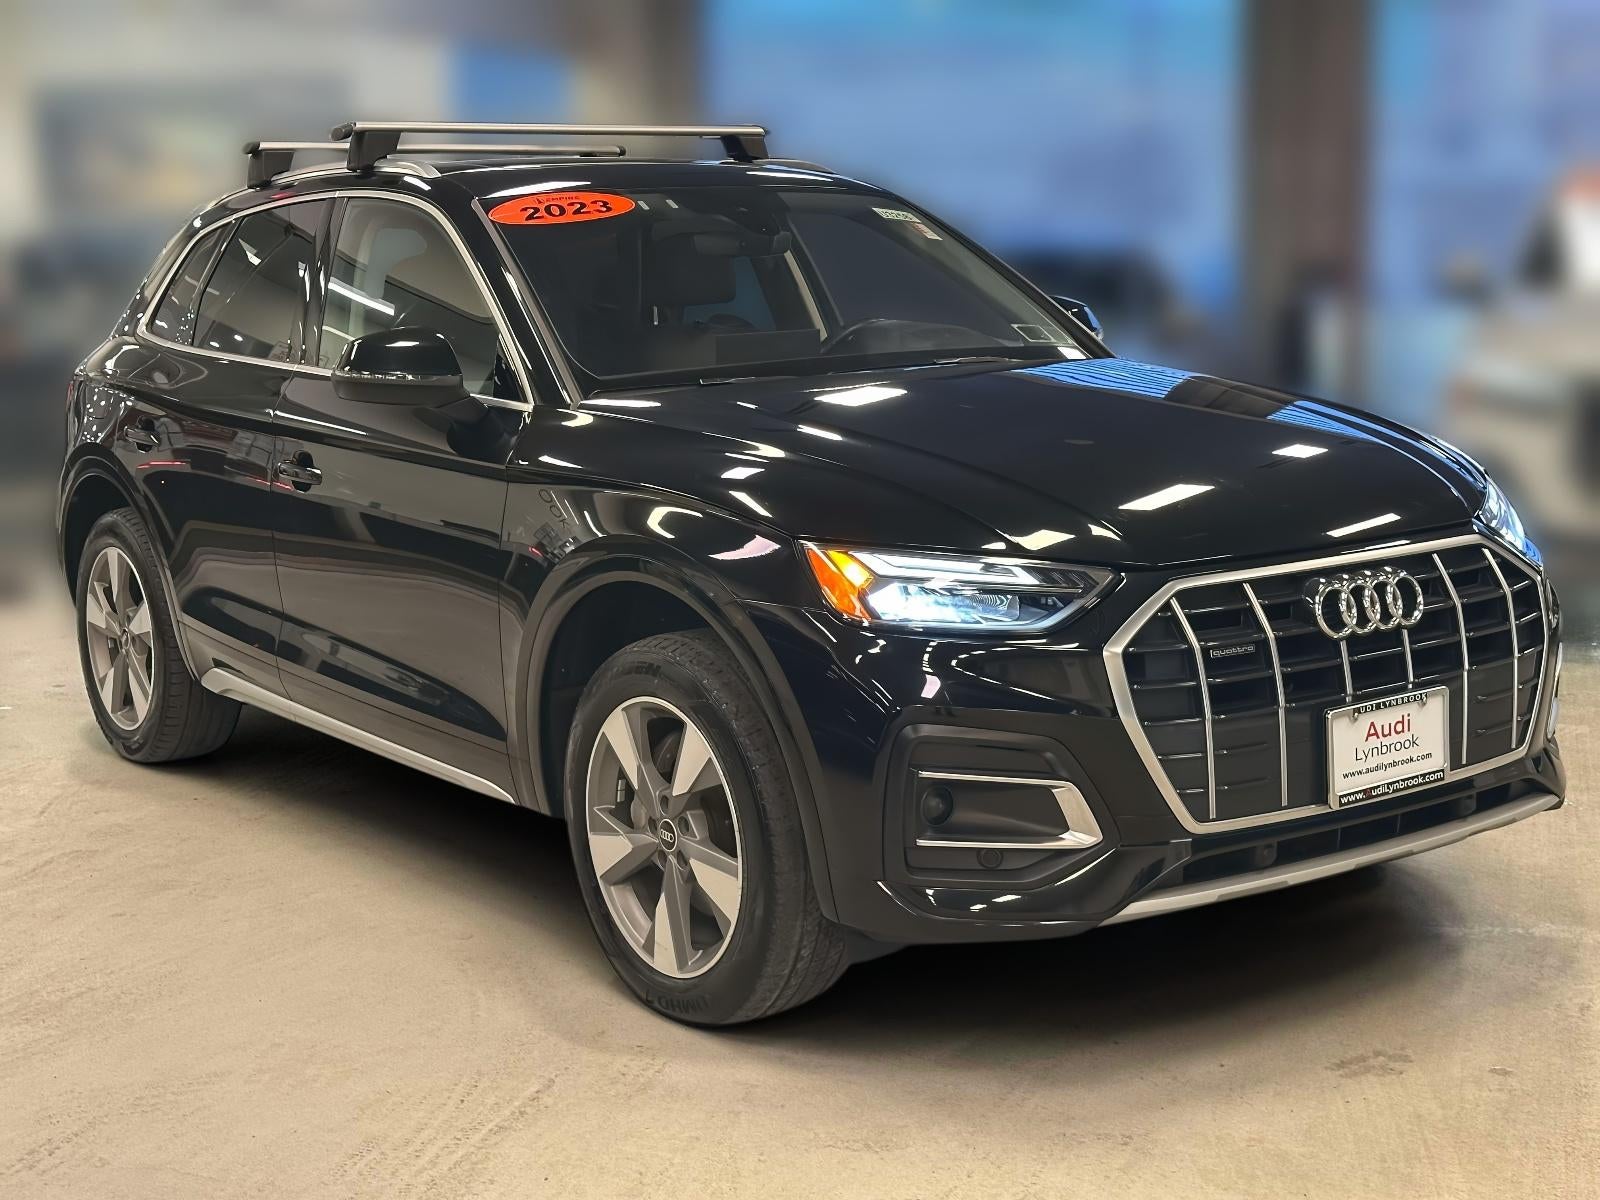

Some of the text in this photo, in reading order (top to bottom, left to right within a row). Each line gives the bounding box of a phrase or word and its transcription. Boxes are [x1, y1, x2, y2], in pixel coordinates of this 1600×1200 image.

[519, 199, 613, 222] 2023
[1212, 645, 1254, 657] quattro
[1353, 692, 1428, 715] UDI LYNBROOK
[1364, 712, 1411, 743] Audi
[1354, 733, 1420, 763] Lynbrook
[1342, 751, 1433, 780] www.audilynbrook.com
[1340, 770, 1444, 804] www.AudiLynbrook.com
